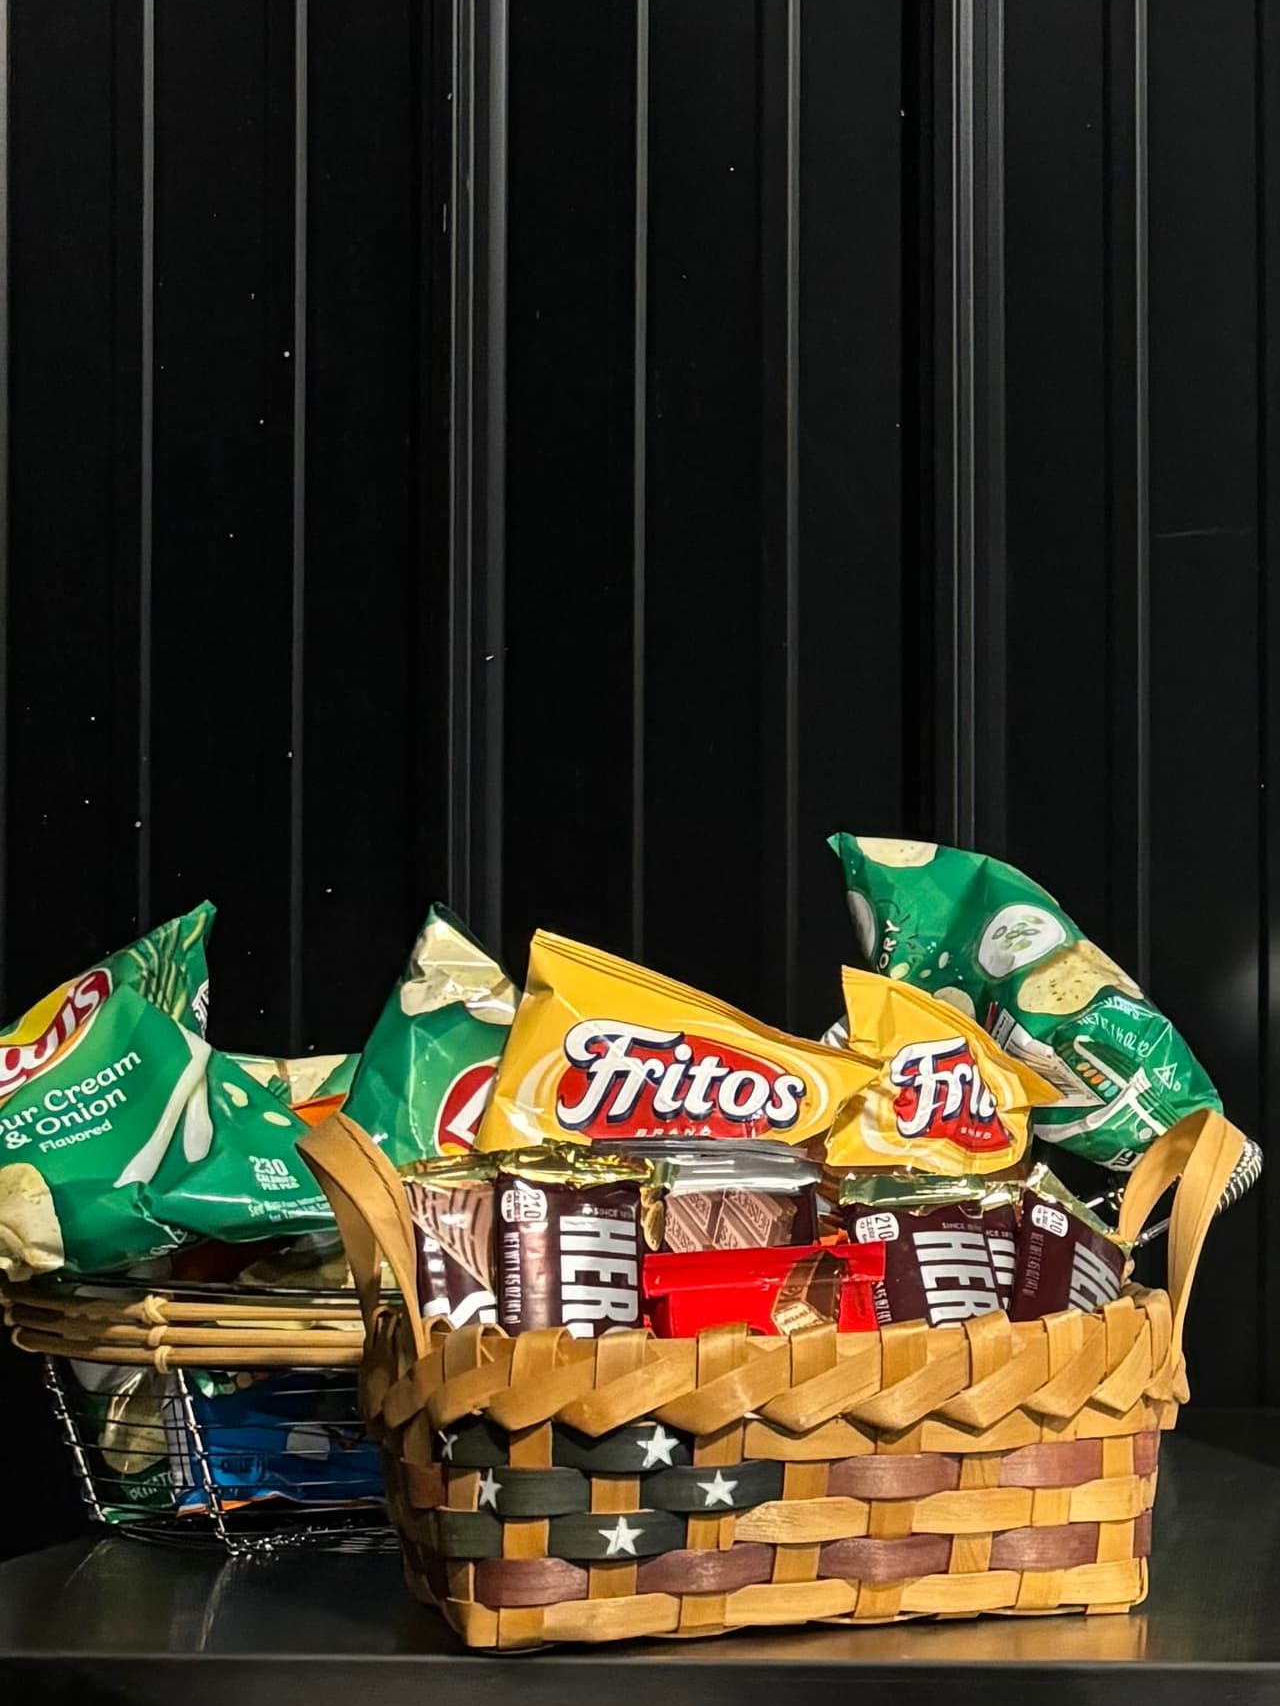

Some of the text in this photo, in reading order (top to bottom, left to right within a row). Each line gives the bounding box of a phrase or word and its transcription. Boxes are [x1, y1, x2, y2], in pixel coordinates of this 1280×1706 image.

[877, 919, 900, 973] ORY
[44, 1050, 142, 1112] Cream
[554, 1019, 807, 1132] Fritos
[5, 1087, 128, 1150] & Onion
[39, 1120, 113, 1153] Flavored
[249, 1155, 288, 1176] 230
[875, 1215, 895, 1241] 210
[1049, 1212, 1065, 1237] 210
